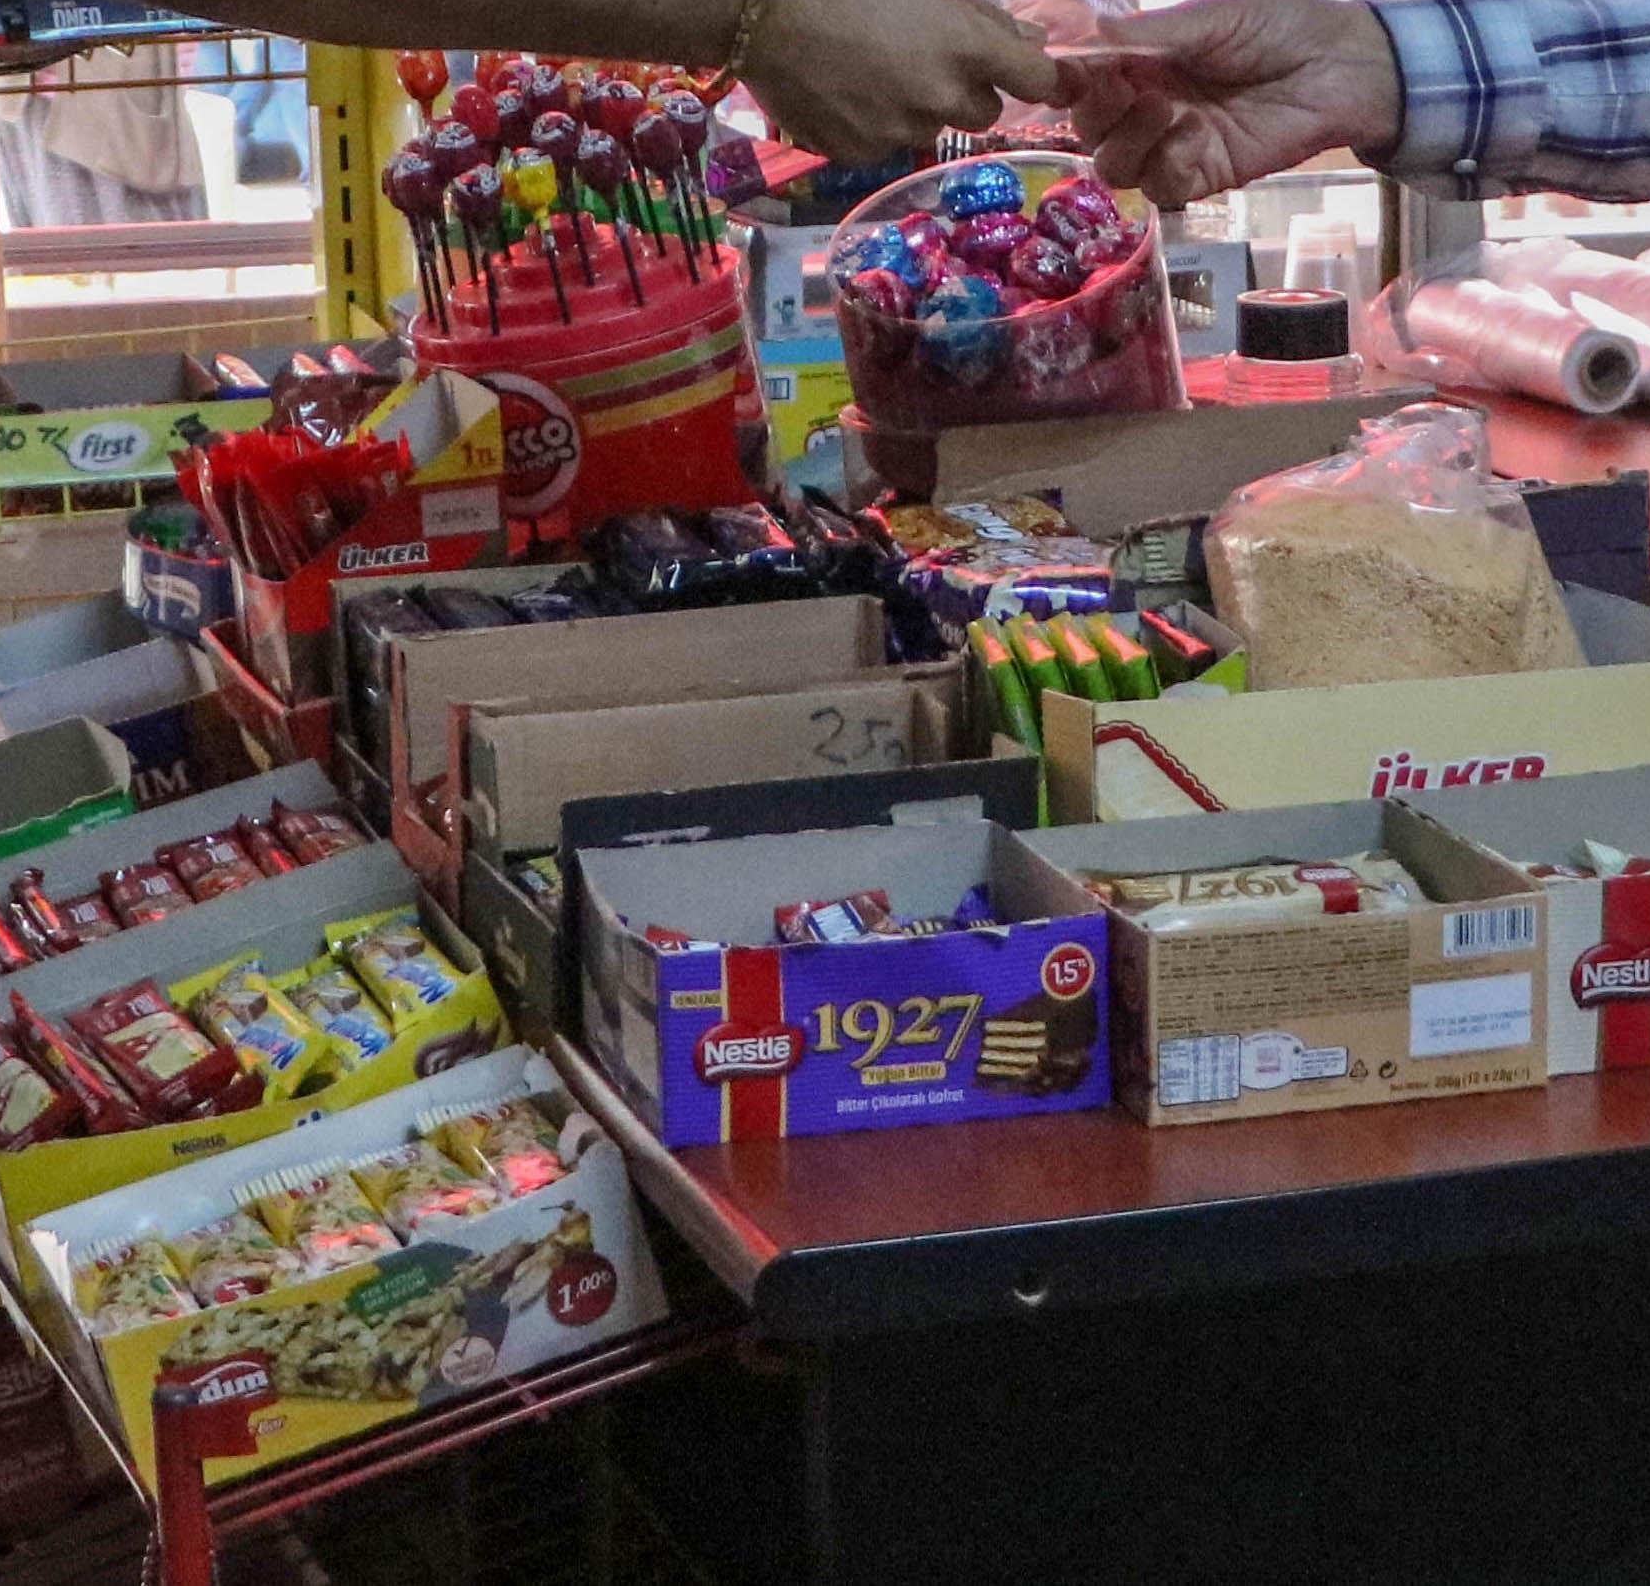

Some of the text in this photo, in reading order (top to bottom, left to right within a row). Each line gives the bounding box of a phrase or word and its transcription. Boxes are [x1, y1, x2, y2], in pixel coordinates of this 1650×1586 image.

[80, 427, 138, 459] first
[339, 542, 429, 572] ÜLKER
[812, 993, 984, 1069] 1927
[703, 1034, 791, 1067] Nestlé
[837, 1097, 870, 1114] Bitter
[199, 1370, 269, 1404] dım
